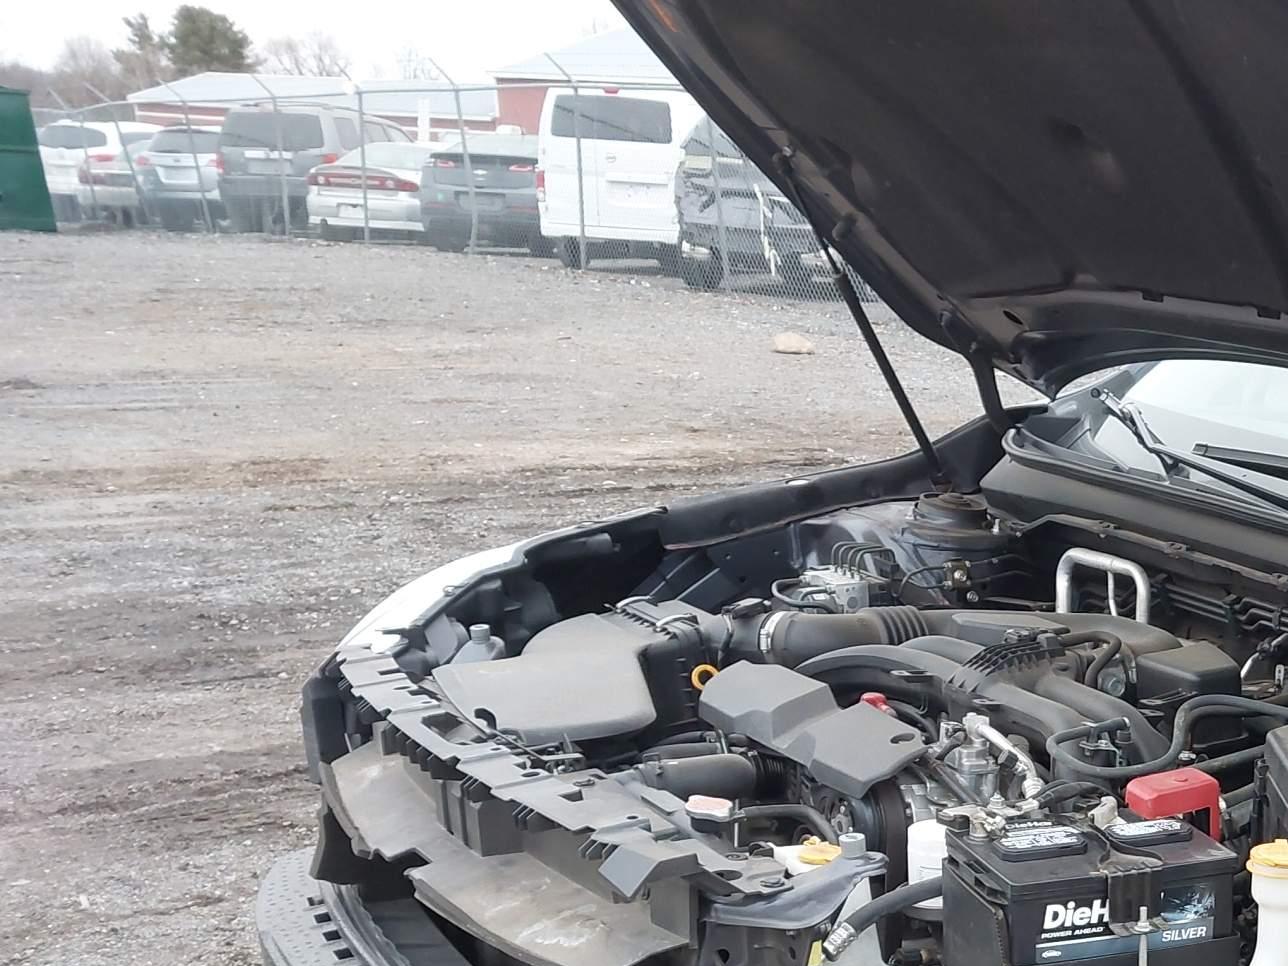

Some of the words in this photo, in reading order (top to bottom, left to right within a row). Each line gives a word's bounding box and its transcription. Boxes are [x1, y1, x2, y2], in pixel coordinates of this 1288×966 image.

[1043, 898, 1110, 930] DieH
[1041, 930, 1072, 939] POWER
[1073, 926, 1105, 936] AHEAD
[1161, 926, 1207, 942] SILVER
